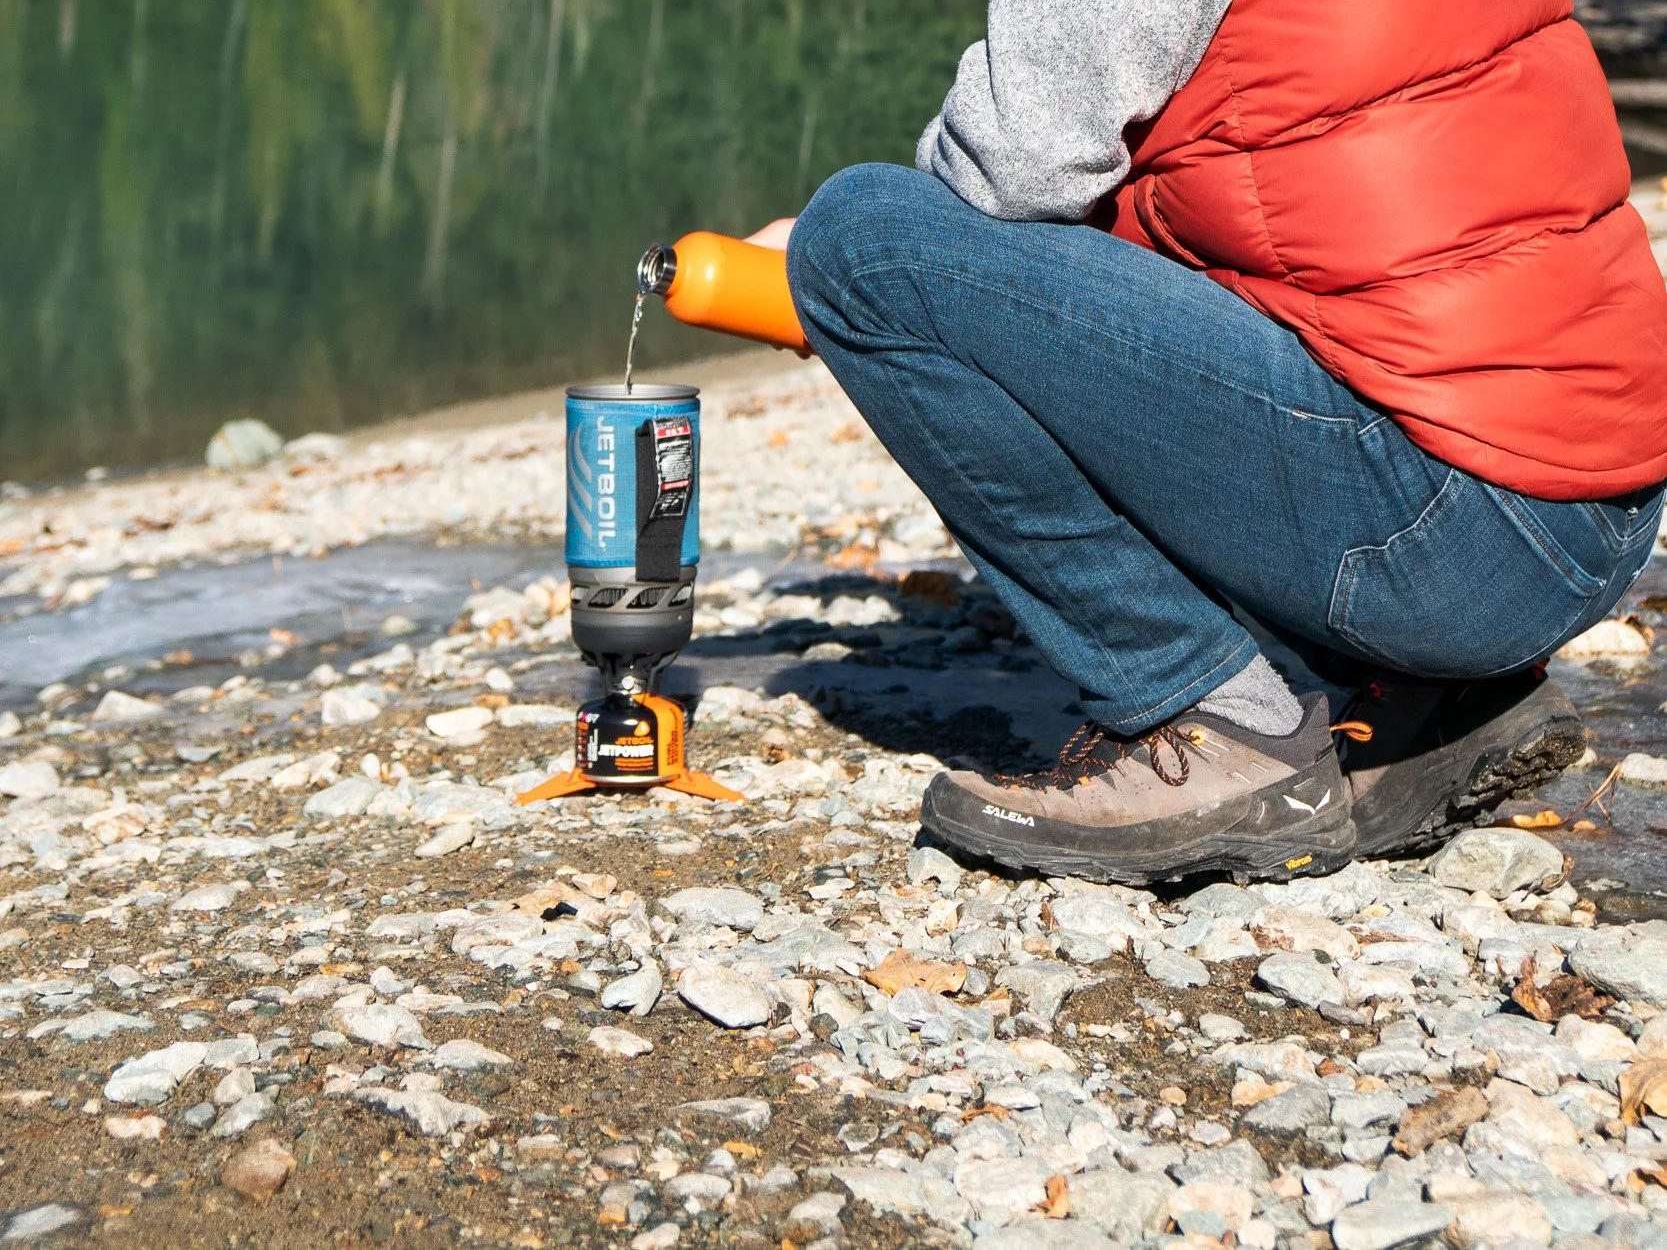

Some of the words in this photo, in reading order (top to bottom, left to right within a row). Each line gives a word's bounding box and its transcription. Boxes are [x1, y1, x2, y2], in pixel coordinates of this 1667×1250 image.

[596, 415, 616, 548] JETBOIL
[598, 744, 654, 758] JETPOWER
[982, 804, 1035, 828] SALEWA
